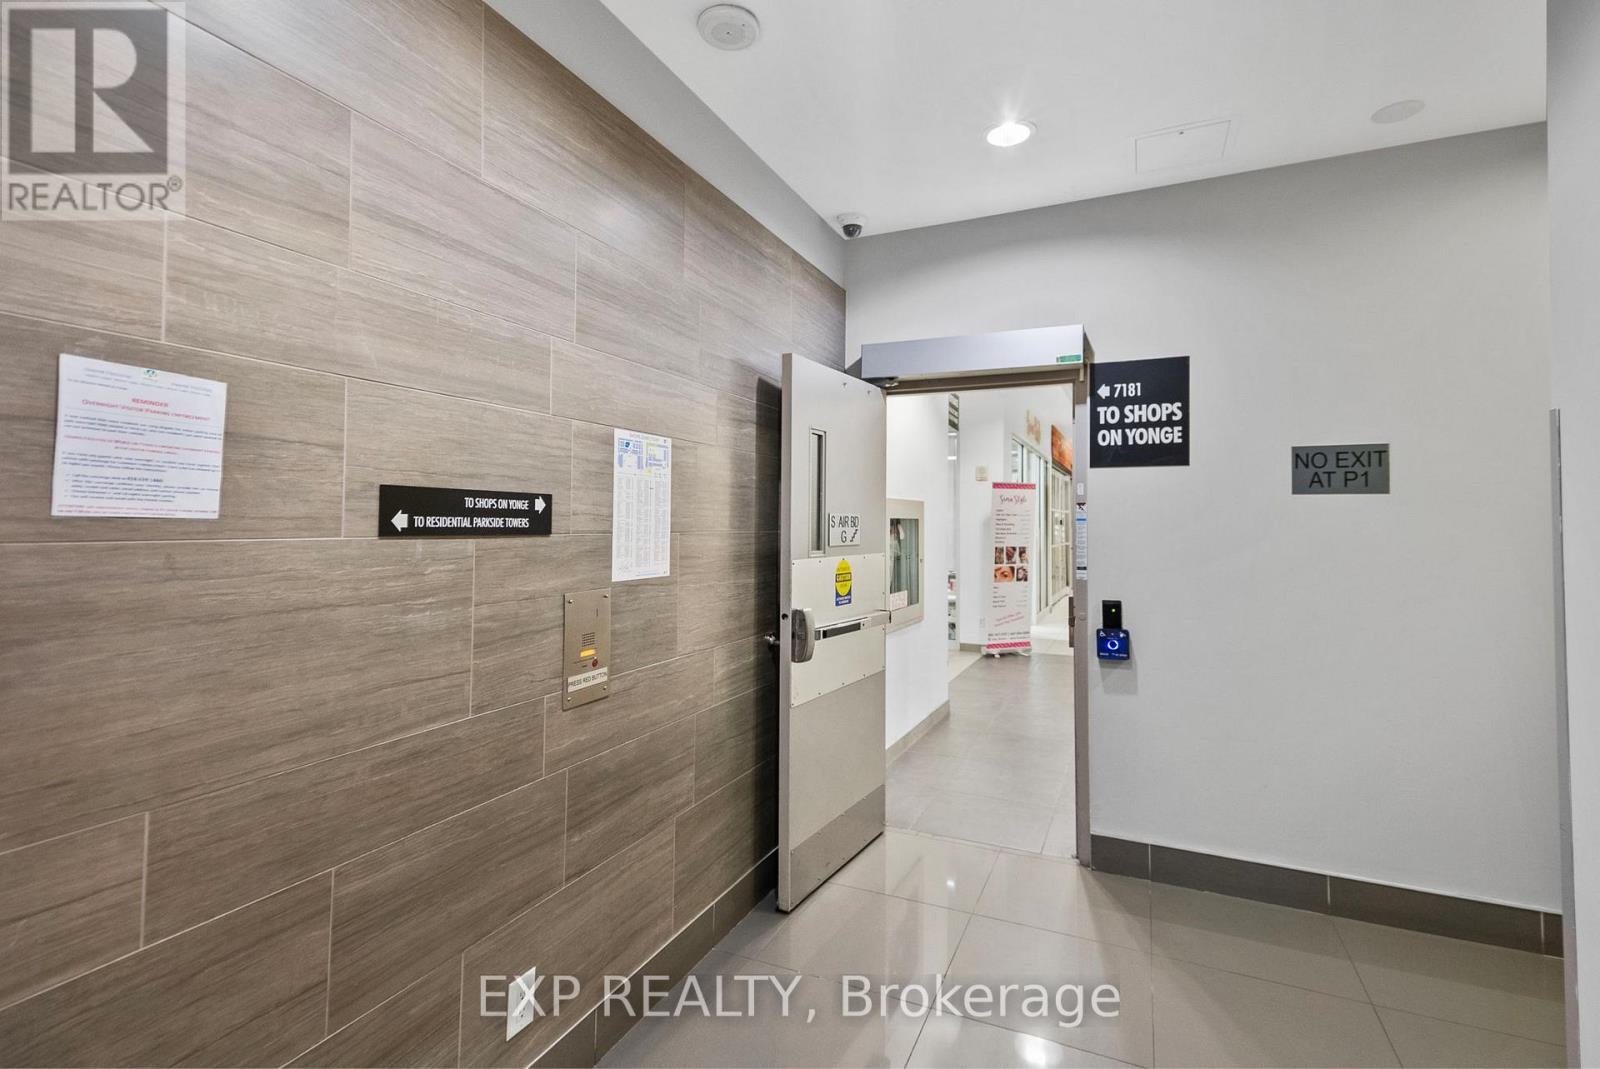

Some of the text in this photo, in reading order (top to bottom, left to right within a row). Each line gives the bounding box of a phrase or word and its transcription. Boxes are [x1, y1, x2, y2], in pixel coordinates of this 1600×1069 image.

[1113, 382, 1142, 398] 7181
[1096, 402, 1183, 425] TO SHOPS
[1097, 426, 1183, 446] ON YONGE
[1295, 450, 1388, 469] NO EXIT
[1309, 471, 1369, 488] AT P1
[464, 497, 529, 510] TO SHOPS ON YONGE
[413, 516, 529, 529] TO RESIDENTIAL PARKSIDE TOWERS
[841, 530, 847, 544] G
